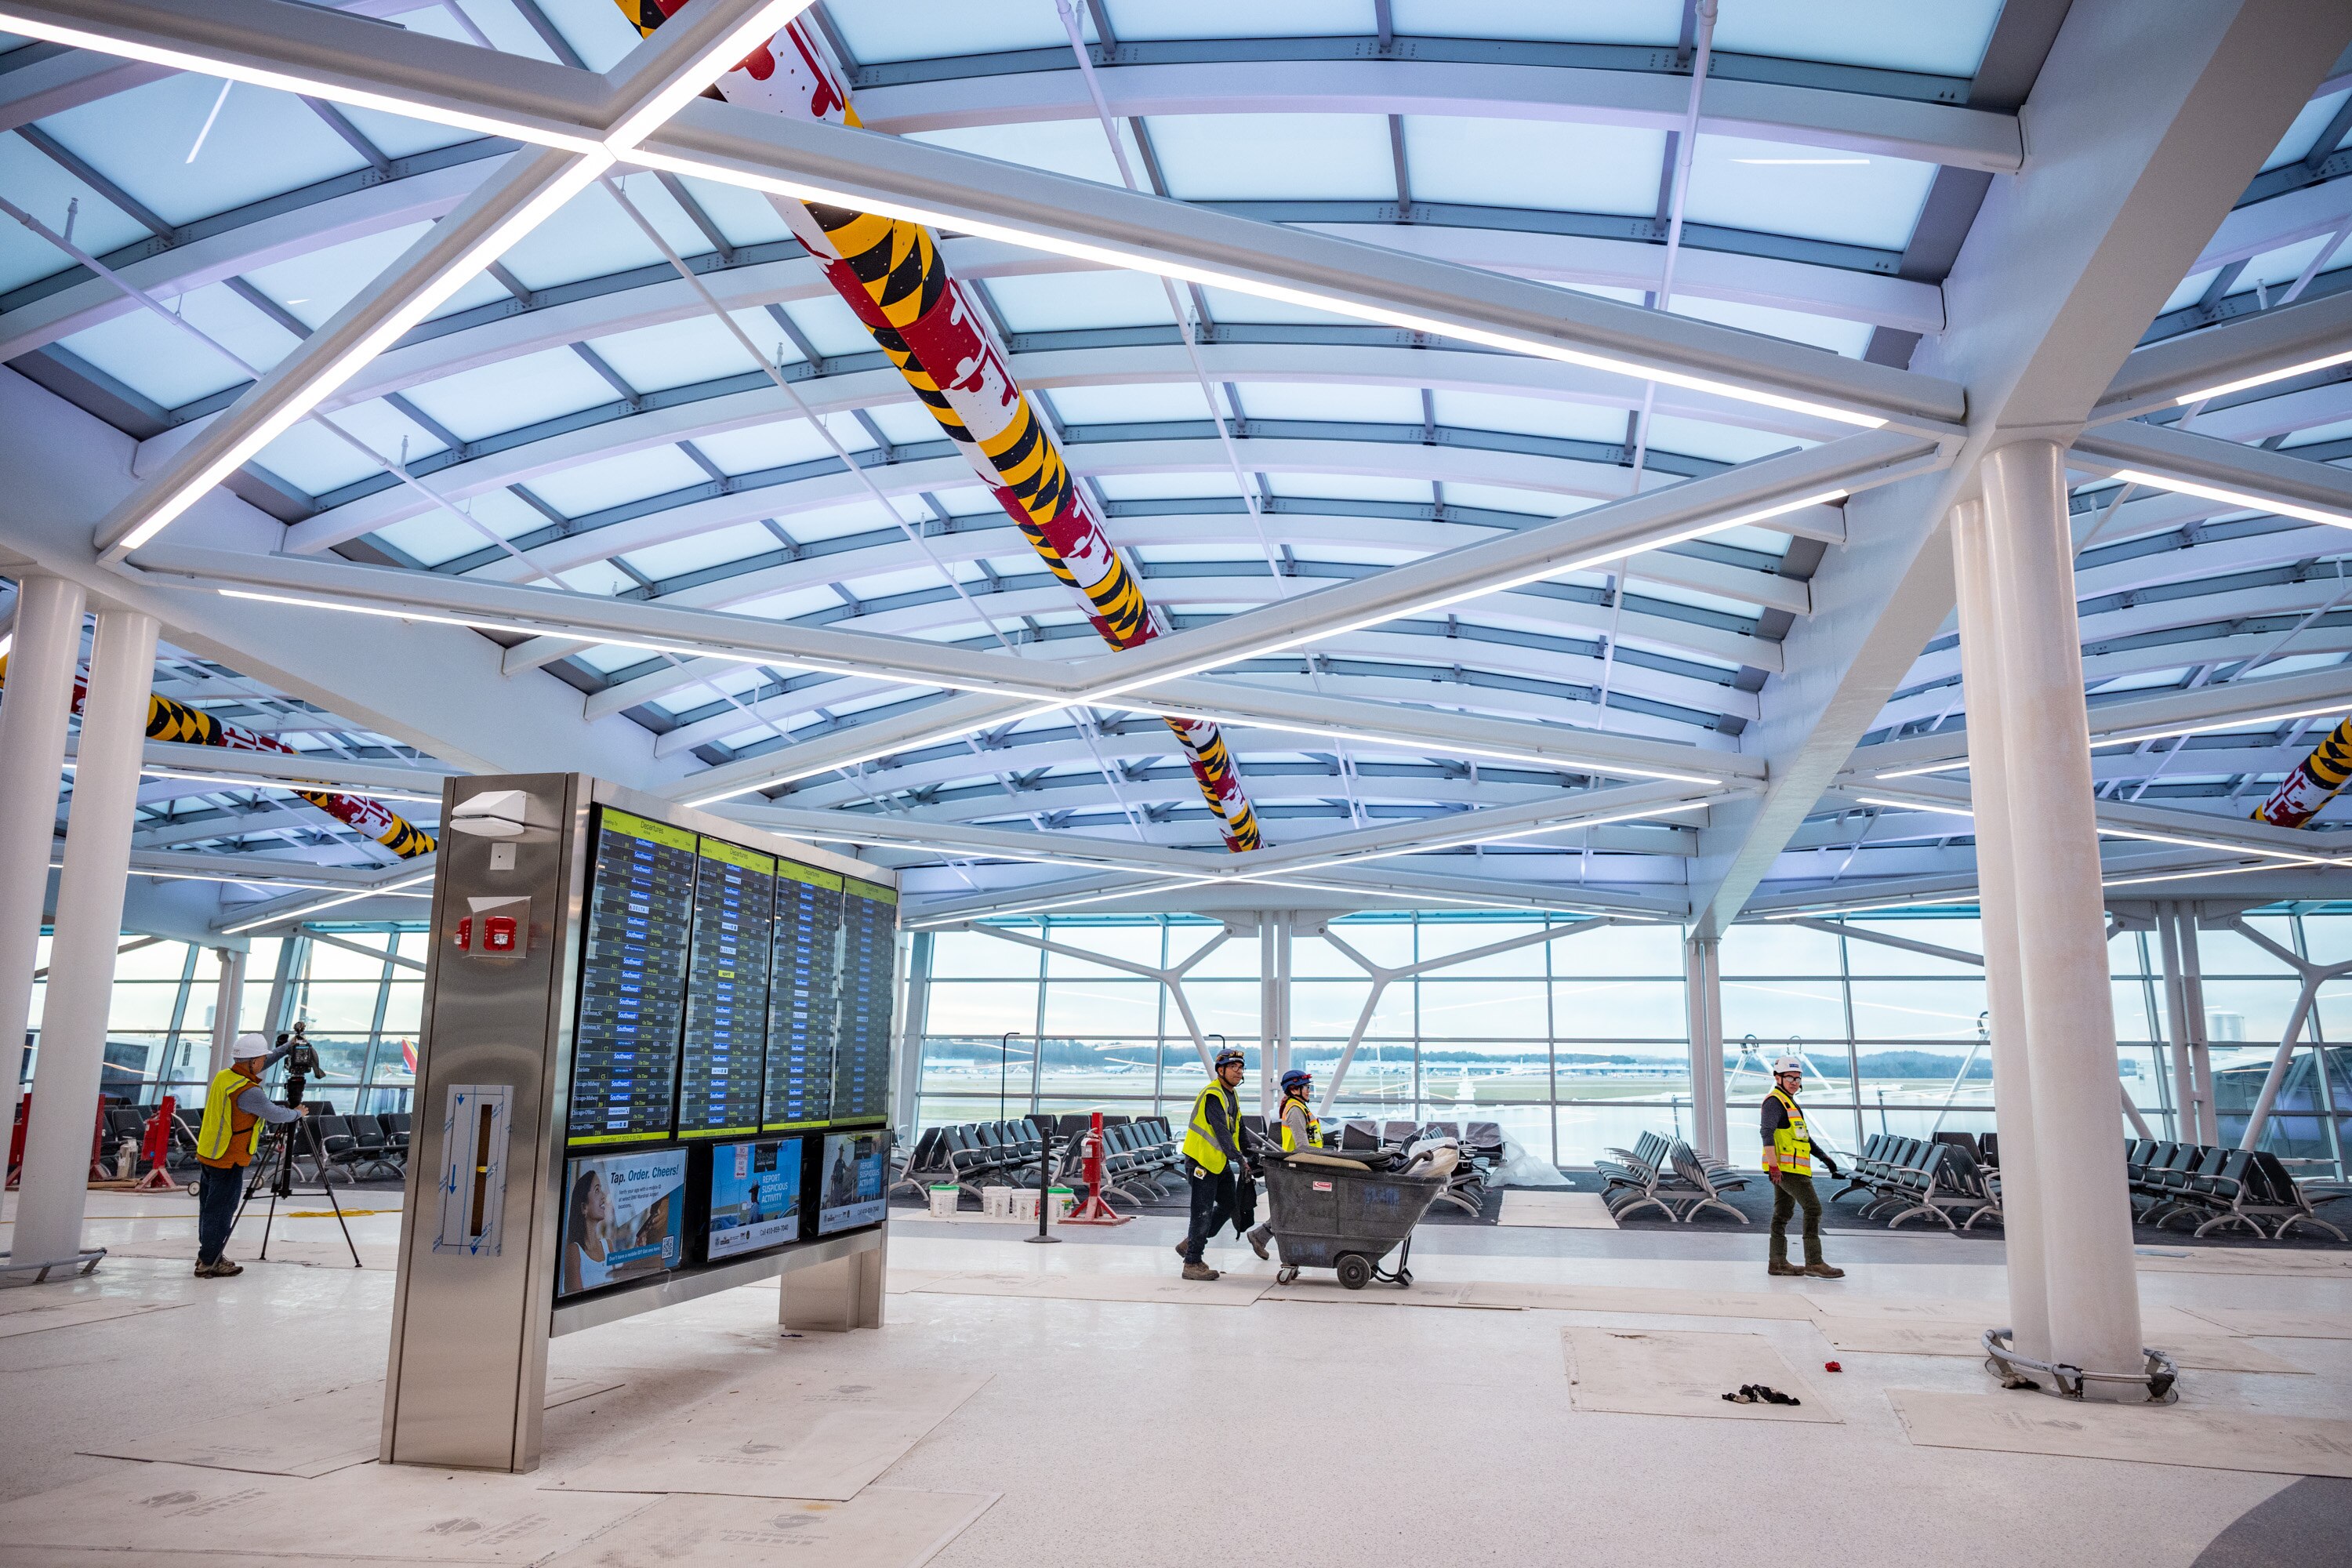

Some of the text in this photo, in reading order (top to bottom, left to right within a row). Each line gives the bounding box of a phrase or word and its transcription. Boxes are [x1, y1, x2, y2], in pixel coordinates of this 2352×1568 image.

[641, 821, 664, 834] Departures
[636, 838, 653, 848] Southwest
[634, 851, 652, 861] Southwest
[730, 848, 748, 859] Departures
[633, 864, 651, 874] Southwest
[727, 864, 740, 873] Southwest
[630, 891, 648, 900] Southwest
[725, 887, 739, 896] Southwest
[724, 898, 738, 907] Southwest
[628, 917, 645, 926] Southwest
[626, 931, 644, 939] Southwest
[624, 957, 641, 966] Southwest
[622, 971, 641, 979] Southwest
[611, 1164, 679, 1185] Tap. Order. Cheers!
[859, 1169, 880, 1178] SUSPICIOUS
[762, 1174, 780, 1183] REPORT
[859, 1178, 875, 1187] ACTIVITY
[762, 1182, 788, 1193] SUSPICIOUS
[761, 1192, 782, 1203] ACTIVITY
